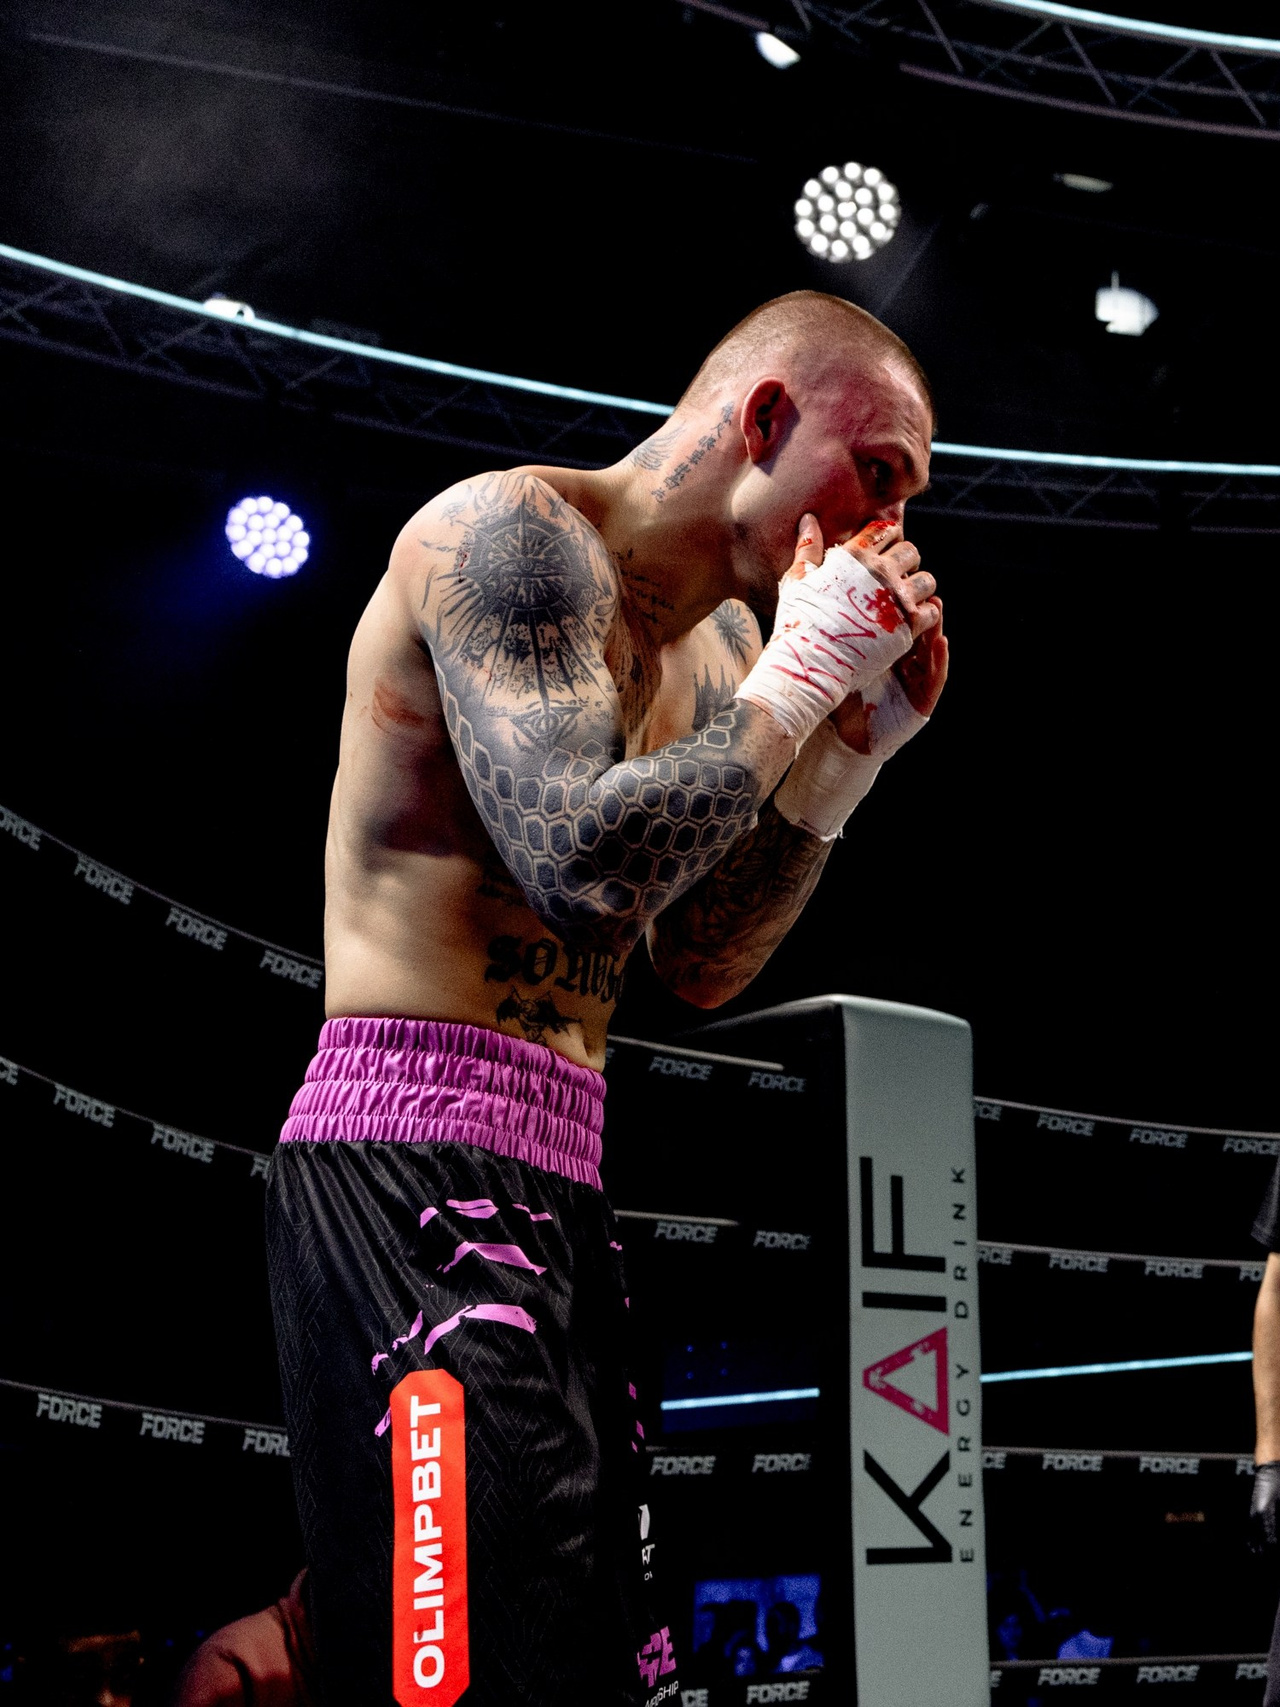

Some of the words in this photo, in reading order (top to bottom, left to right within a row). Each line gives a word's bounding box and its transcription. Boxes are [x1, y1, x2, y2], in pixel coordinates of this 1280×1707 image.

[0, 806, 42, 852] ORCE
[73, 848, 134, 905] FORCE
[165, 907, 227, 951] FORCE
[260, 951, 323, 989] FORCE
[648, 1056, 713, 1082] FORCE
[53, 1085, 115, 1128] FORCE
[151, 1126, 214, 1164] FORCE
[1036, 1112, 1095, 1137] FORCE
[1129, 1128, 1188, 1149] FORCE
[1222, 1137, 1280, 1155] FORCE
[653, 1223, 718, 1244] FORCE
[951, 1167, 969, 1319] DRINK
[1049, 1253, 1110, 1273] FORCE
[1144, 1260, 1204, 1279] FORCE
[35, 1393, 103, 1429] FORCE
[139, 1413, 205, 1445] FORCE
[242, 1428, 290, 1457] FOR
[649, 1455, 716, 1475] FORCE
[955, 1364, 974, 1563] ENERGY
[1042, 1454, 1104, 1473] FORCE
[1139, 1458, 1200, 1475] FORCE
[409, 1395, 445, 1688] OLIMPBET
[746, 1680, 810, 1705] FORCE
[1038, 1667, 1100, 1686] FORCE
[1136, 1665, 1198, 1683] FORCE
